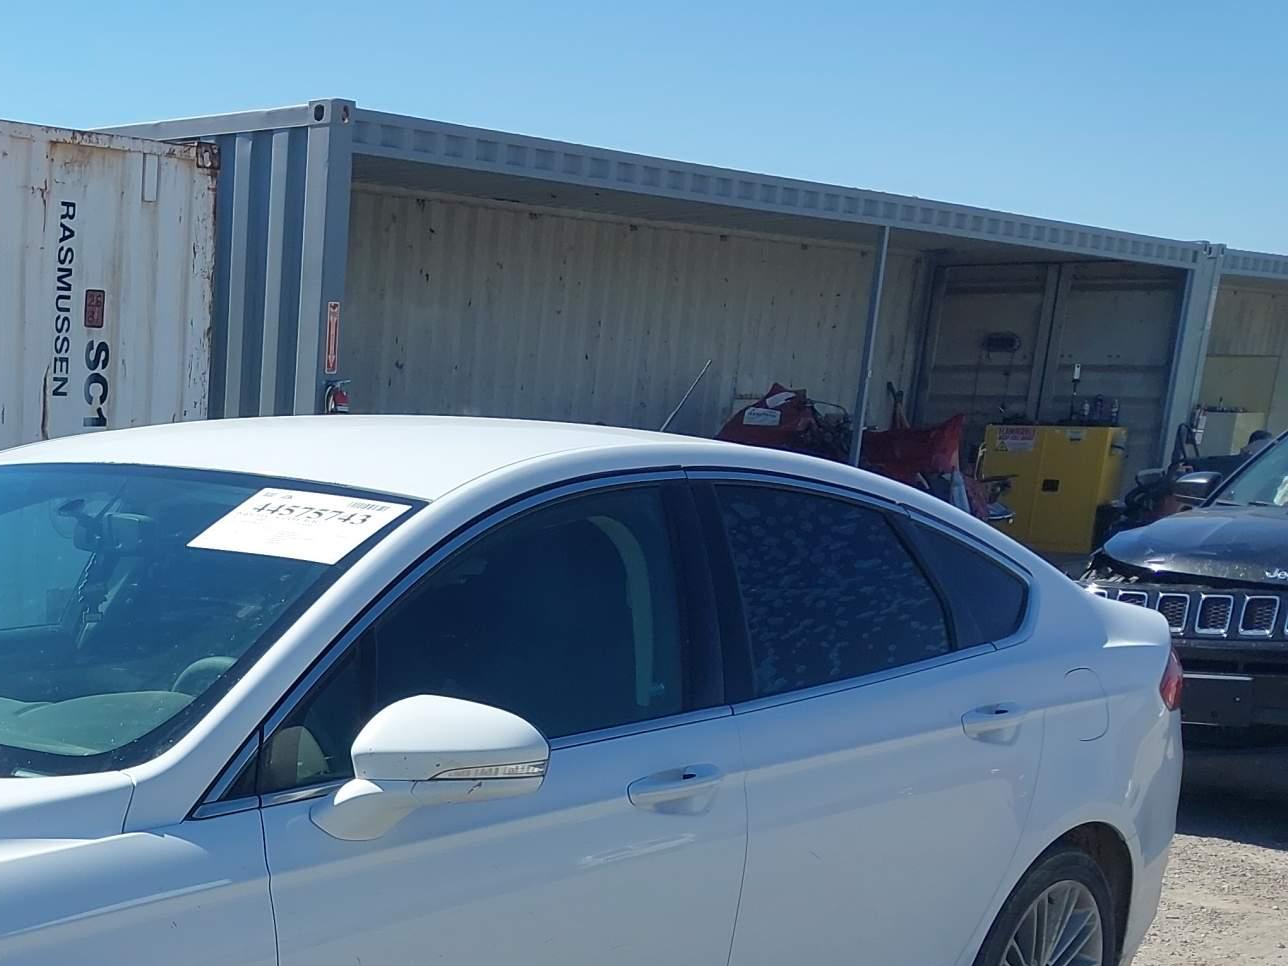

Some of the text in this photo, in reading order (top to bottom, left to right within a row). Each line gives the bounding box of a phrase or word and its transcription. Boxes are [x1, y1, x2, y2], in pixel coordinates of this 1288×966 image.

[52, 201, 76, 397] RASMUSSEN
[253, 502, 372, 525] 44575743
[1264, 567, 1288, 580] Je
